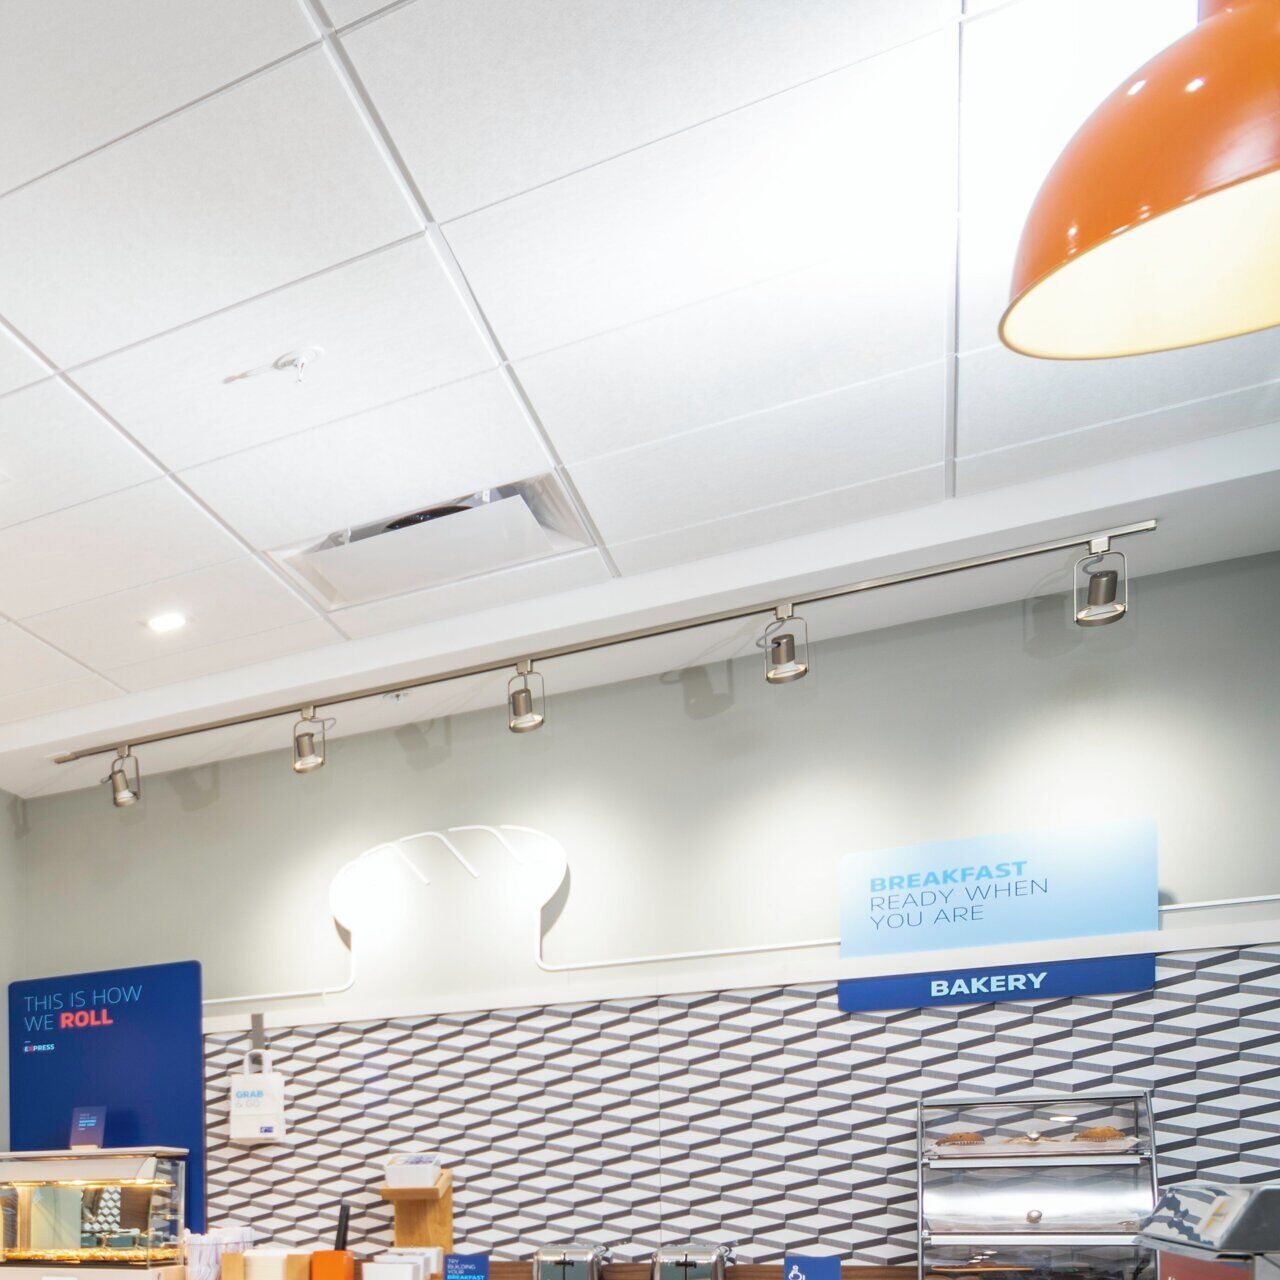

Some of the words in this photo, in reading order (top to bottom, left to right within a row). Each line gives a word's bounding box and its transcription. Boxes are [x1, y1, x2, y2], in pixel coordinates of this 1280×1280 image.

[870, 860, 1028, 893] BREAKFAST
[870, 888, 954, 912] READY
[965, 878, 1048, 901] WHEN
[870, 911, 923, 930] YOU
[934, 904, 985, 924] ARE
[931, 972, 1048, 997] BAKERY
[24, 993, 64, 1012] THIS
[71, 990, 86, 1007] IS
[93, 985, 143, 1005] HOW
[24, 1013, 54, 1032] WE
[60, 1008, 114, 1029] ROLL
[24, 1044, 55, 1052] EXPRESS
[236, 1090, 264, 1098] GRAB
